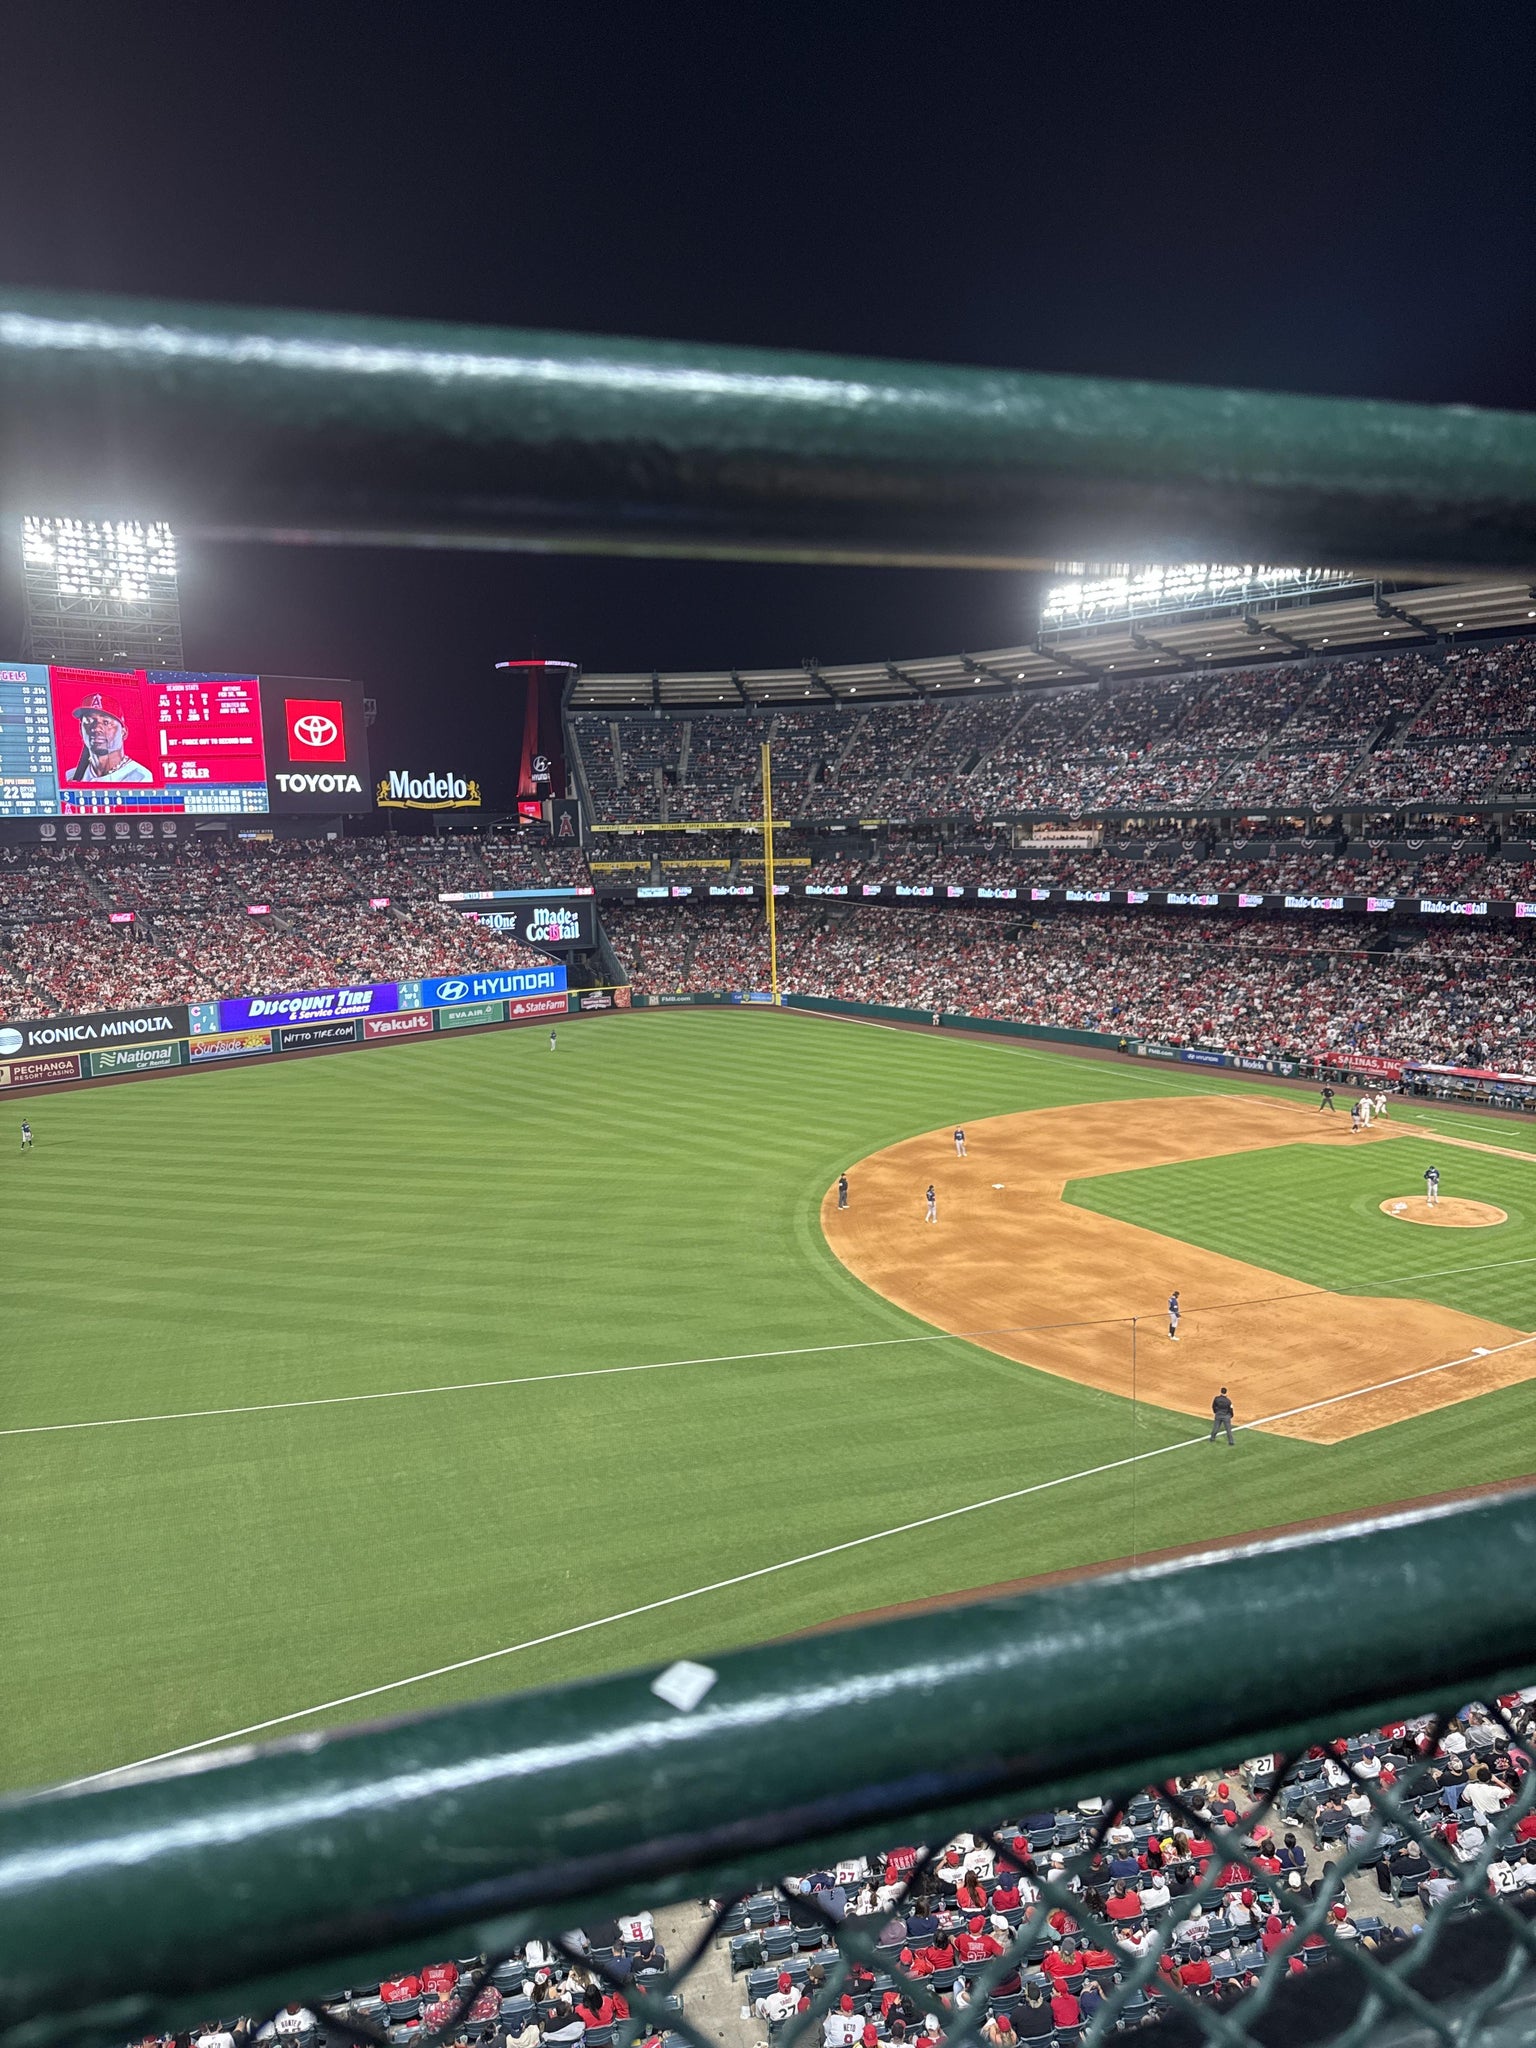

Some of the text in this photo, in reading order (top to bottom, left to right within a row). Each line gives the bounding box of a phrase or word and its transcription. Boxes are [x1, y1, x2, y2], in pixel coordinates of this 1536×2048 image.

[0, 670, 27, 682] GELS
[162, 762, 210, 778] 12 SOLER
[275, 774, 362, 793] TOYOTA
[389, 770, 467, 798] Modelo
[3, 786, 20, 799] 22
[141, 823, 151, 832] 42
[559, 811, 575, 836] A
[1420, 900, 1446, 913] Made
[534, 907, 571, 926] Made
[526, 921, 580, 941] Cocktail
[473, 972, 555, 996] HYUNDAI
[248, 990, 373, 1017] DISCOUNT TIRE
[191, 1006, 201, 1017] C
[289, 1004, 369, 1021] & Service Centers
[449, 1009, 483, 1020] EVA AIR
[28, 1016, 173, 1046] KONICA MINOLTA
[368, 1016, 429, 1033] Yakult
[283, 1026, 353, 1043] NITTO TIRE.COM
[194, 1039, 242, 1056] Surfside
[116, 1046, 171, 1065] National
[1196, 1053, 1219, 1062] HYUNDAI
[1337, 1055, 1379, 1069] SALINAS,
[14, 1060, 73, 1075] PECHANGA
[1242, 1059, 1264, 1070] Modelo
[14, 1068, 74, 1081] RESORT CASINO
[1392, 1726, 1406, 1739] 27
[1257, 1759, 1271, 1772] 27
[839, 1872, 855, 1882] 27
[974, 1864, 990, 1879] 27
[1231, 1862, 1244, 1884] A
[1499, 1870, 1515, 1886] 27
[632, 1928, 644, 1940] 9
[778, 2004, 796, 2018] 27
[843, 2023, 856, 2032] NETO
